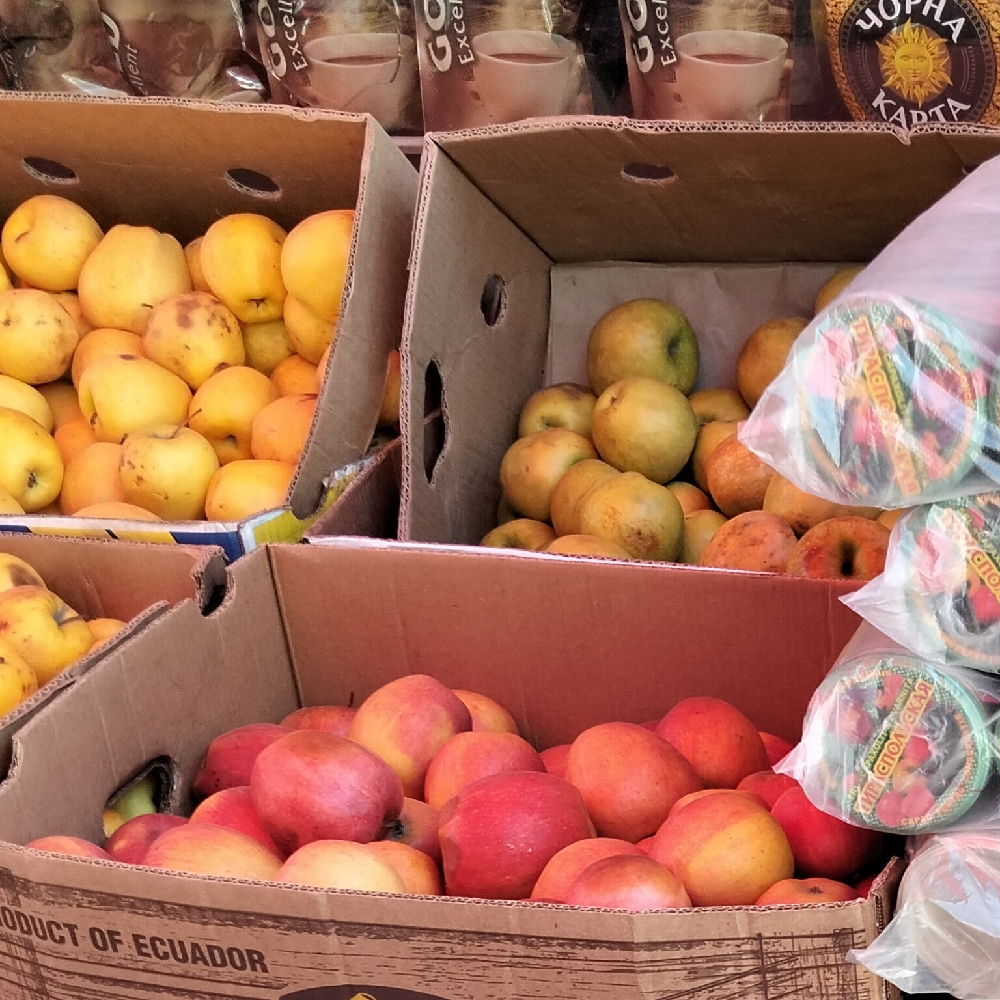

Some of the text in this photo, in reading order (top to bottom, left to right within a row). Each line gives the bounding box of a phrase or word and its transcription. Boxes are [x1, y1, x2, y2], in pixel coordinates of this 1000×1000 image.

[855, 0, 966, 43] ЧОРНА
[872, 88, 971, 129] КАРТА
[0, 906, 269, 974] ODUCT OF ECUADOR
